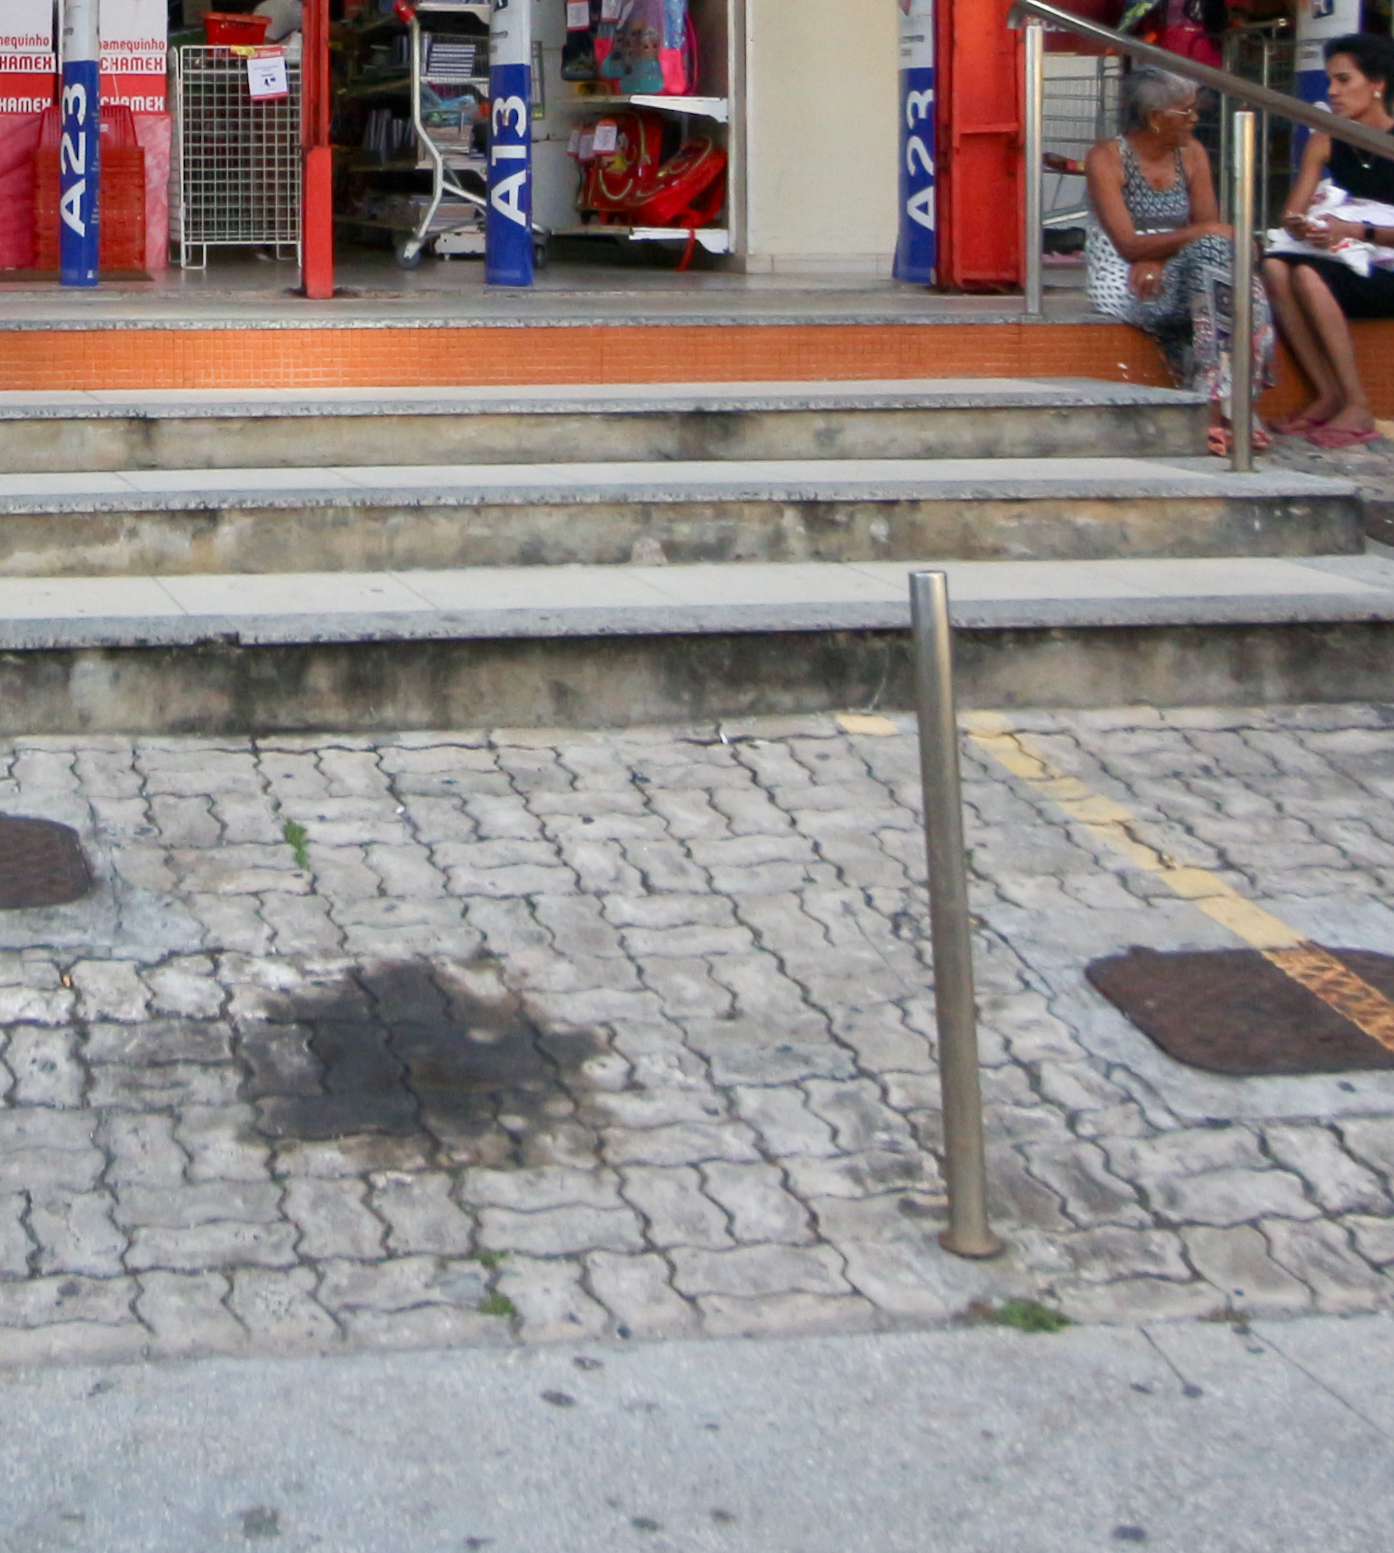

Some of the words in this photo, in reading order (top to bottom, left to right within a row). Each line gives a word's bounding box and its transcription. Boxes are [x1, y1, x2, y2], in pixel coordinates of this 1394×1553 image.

[99, 37, 165, 53] amequinho
[100, 57, 163, 71] CHAMEX
[60, 83, 87, 238] A23
[491, 95, 527, 227] A13
[906, 89, 934, 231] A23
